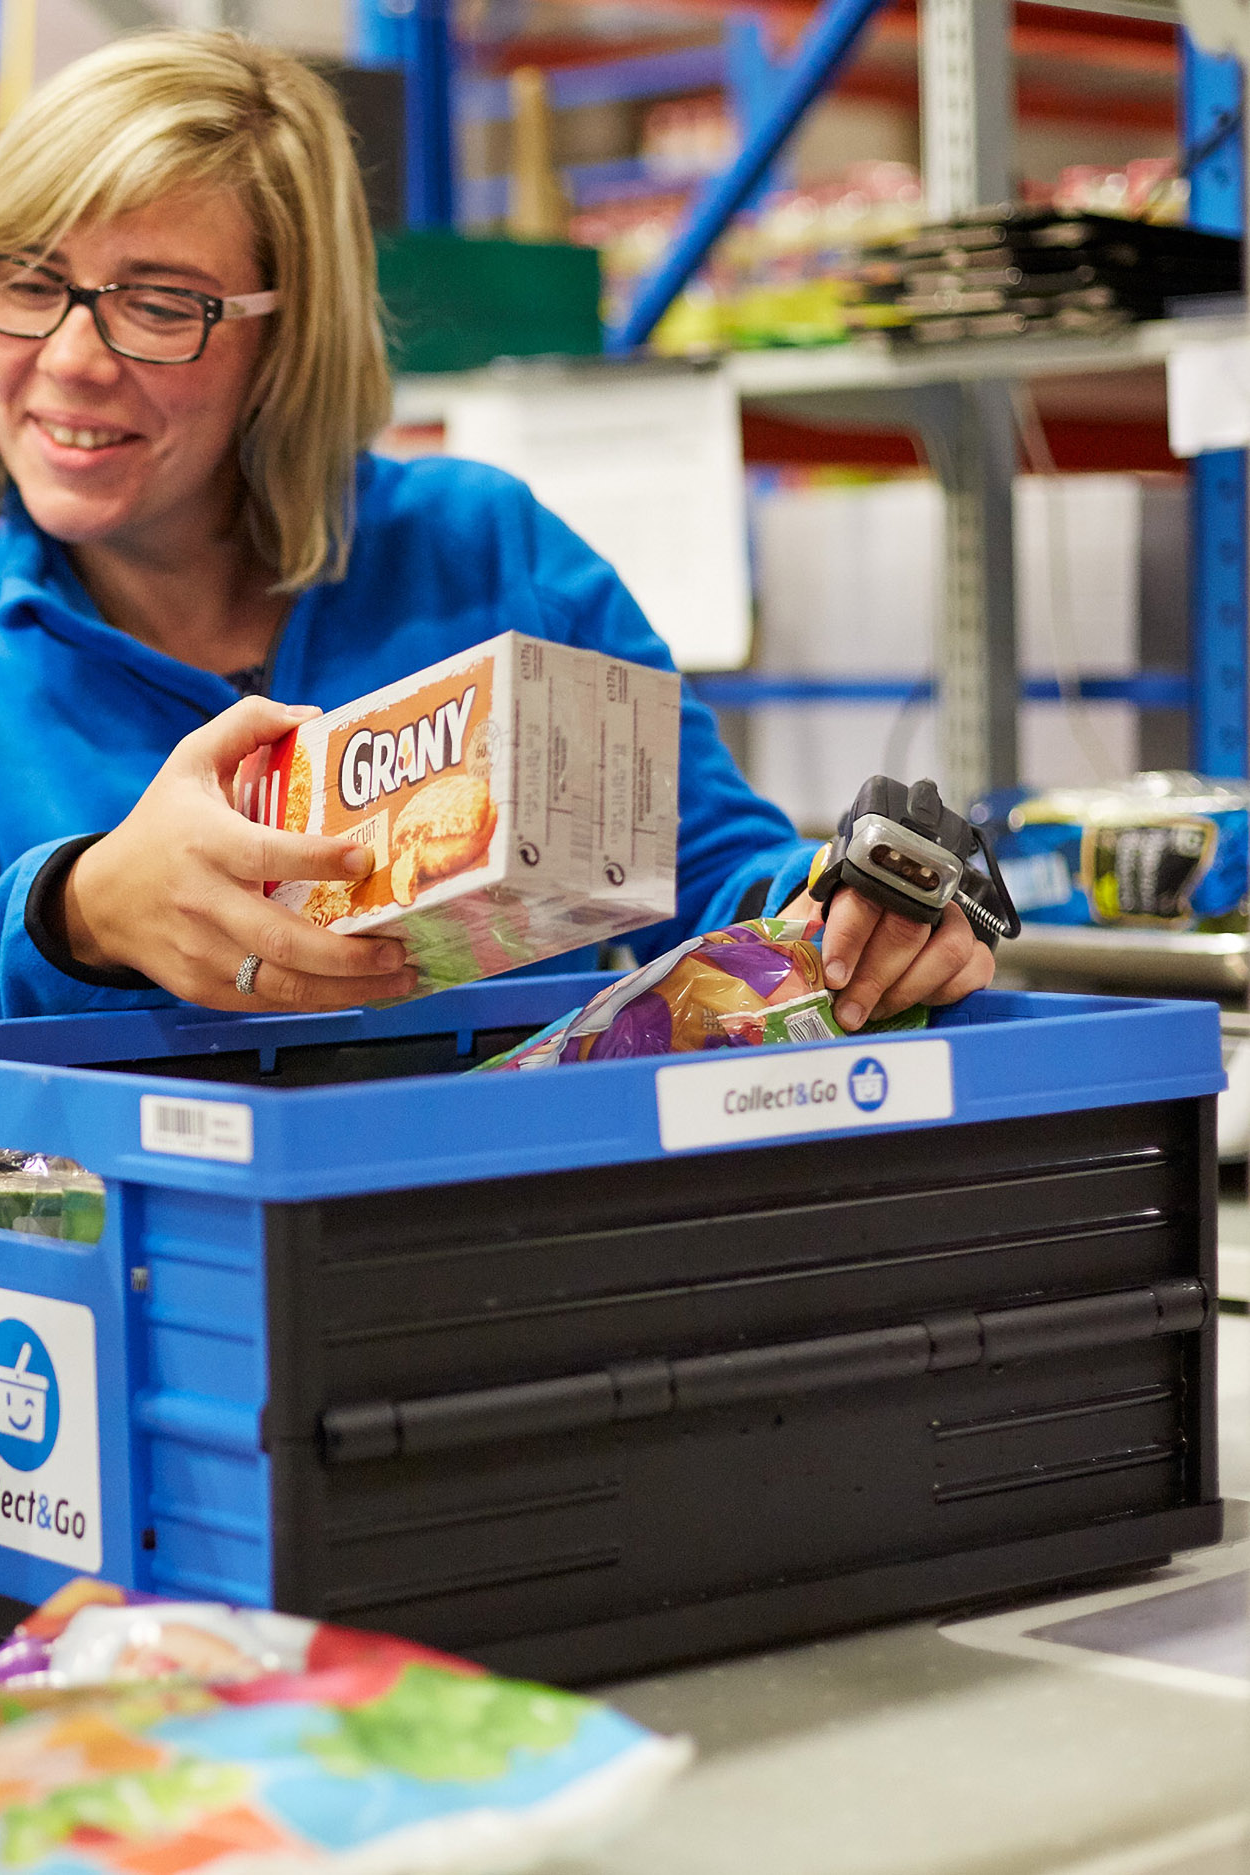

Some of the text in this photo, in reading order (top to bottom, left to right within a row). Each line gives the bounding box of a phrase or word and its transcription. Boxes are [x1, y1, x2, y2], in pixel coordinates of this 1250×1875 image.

[339, 685, 476, 809] GRANY
[347, 819, 376, 845] CUIT
[724, 1079, 837, 1115] Collect&Go
